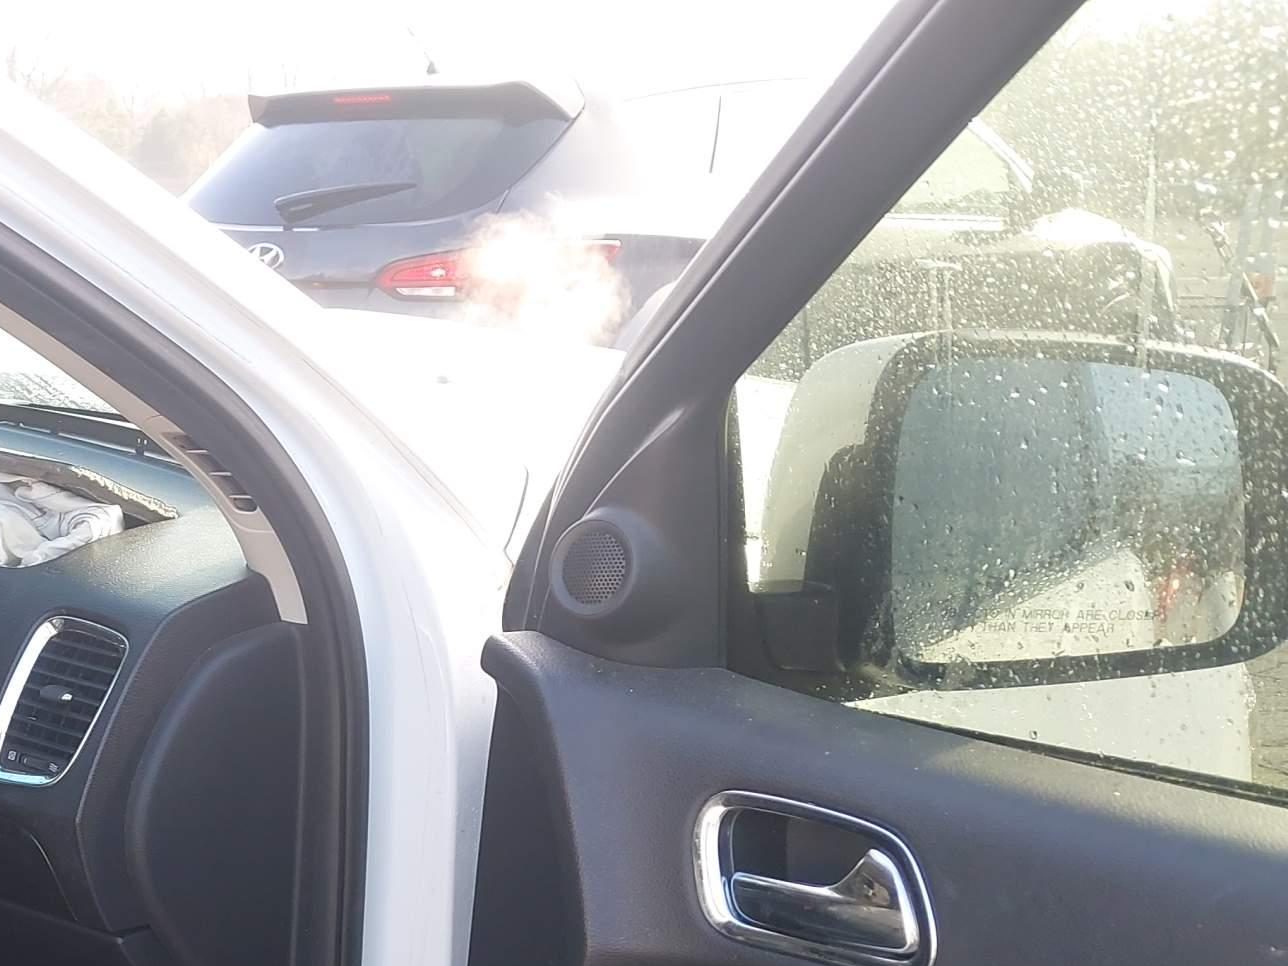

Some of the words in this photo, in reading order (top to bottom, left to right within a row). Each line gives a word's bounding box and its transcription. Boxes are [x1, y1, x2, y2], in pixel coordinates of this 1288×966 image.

[1077, 609, 1103, 621] ARE
[983, 621, 1016, 633] THAN
[1063, 622, 1115, 634] APPEAR
